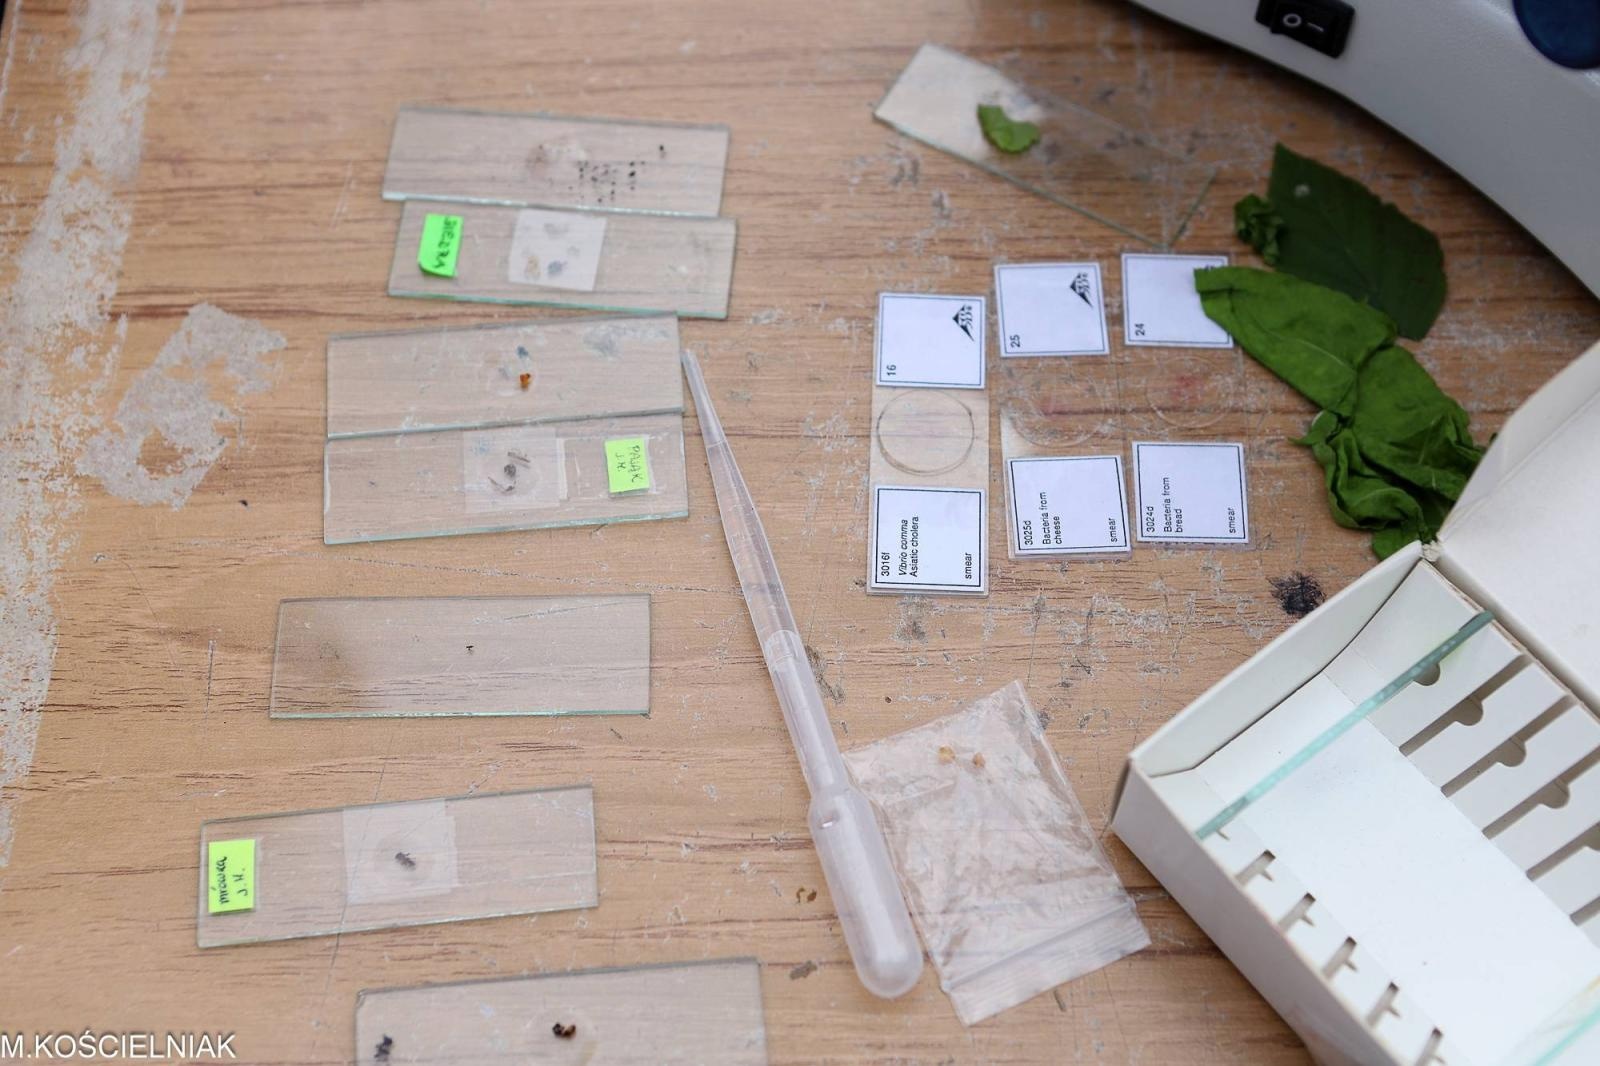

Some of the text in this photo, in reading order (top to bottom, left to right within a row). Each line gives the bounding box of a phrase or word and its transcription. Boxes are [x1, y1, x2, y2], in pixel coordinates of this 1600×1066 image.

[1010, 333, 1021, 348] 25
[1135, 322, 1146, 336] 24
[886, 364, 897, 376] 16
[1039, 491, 1052, 545] Bacteria from
[1162, 477, 1172, 533] Bacteria from
[1023, 520, 1033, 545] 3025d
[1053, 516, 1062, 545] cheese
[1108, 517, 1118, 543] smear
[1146, 506, 1156, 533] 3024d
[1174, 508, 1183, 533] bread
[1228, 507, 1236, 534] smear
[909, 516, 919, 578] Asiatic cholera
[881, 552, 890, 577] 3016f
[899, 552, 908, 576] Vibrio
[964, 552, 972, 580] smear
